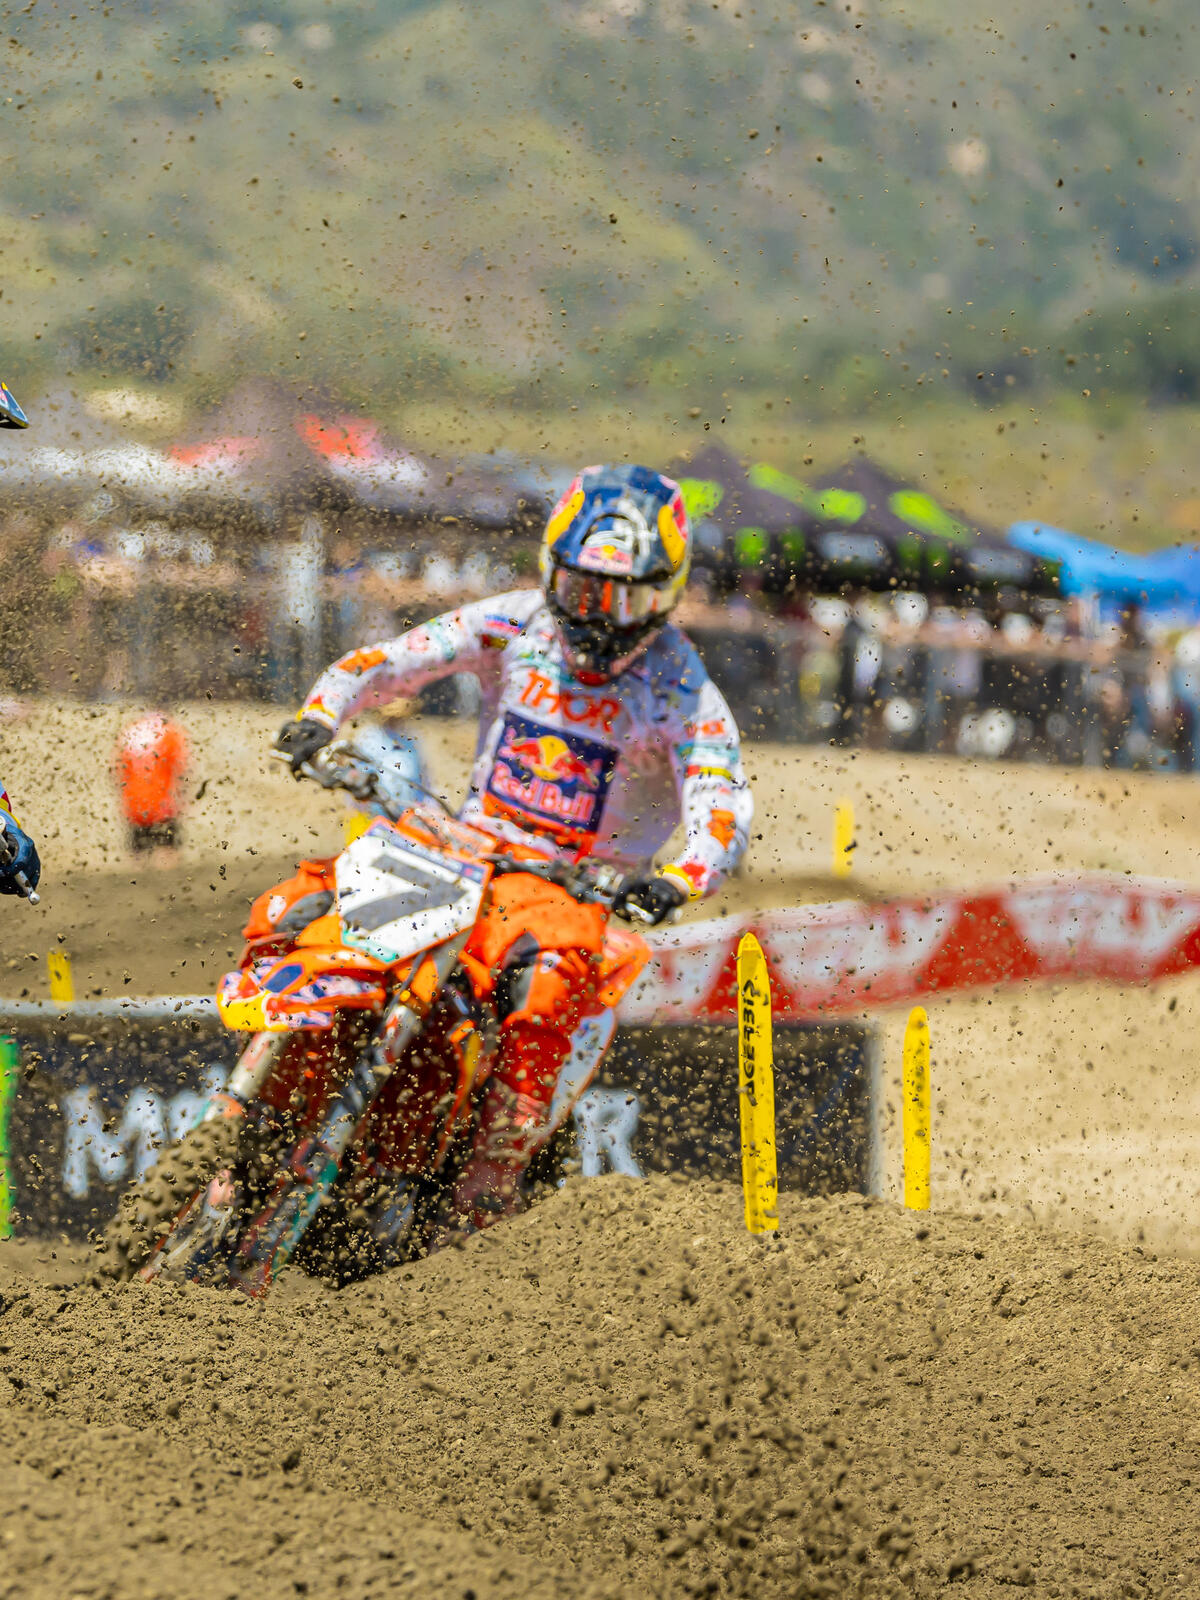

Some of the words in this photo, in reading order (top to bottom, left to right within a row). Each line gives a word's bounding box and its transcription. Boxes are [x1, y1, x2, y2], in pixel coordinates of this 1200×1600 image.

[520, 667, 622, 733] THOR
[491, 760, 543, 806] Red
[539, 780, 598, 823] Bull
